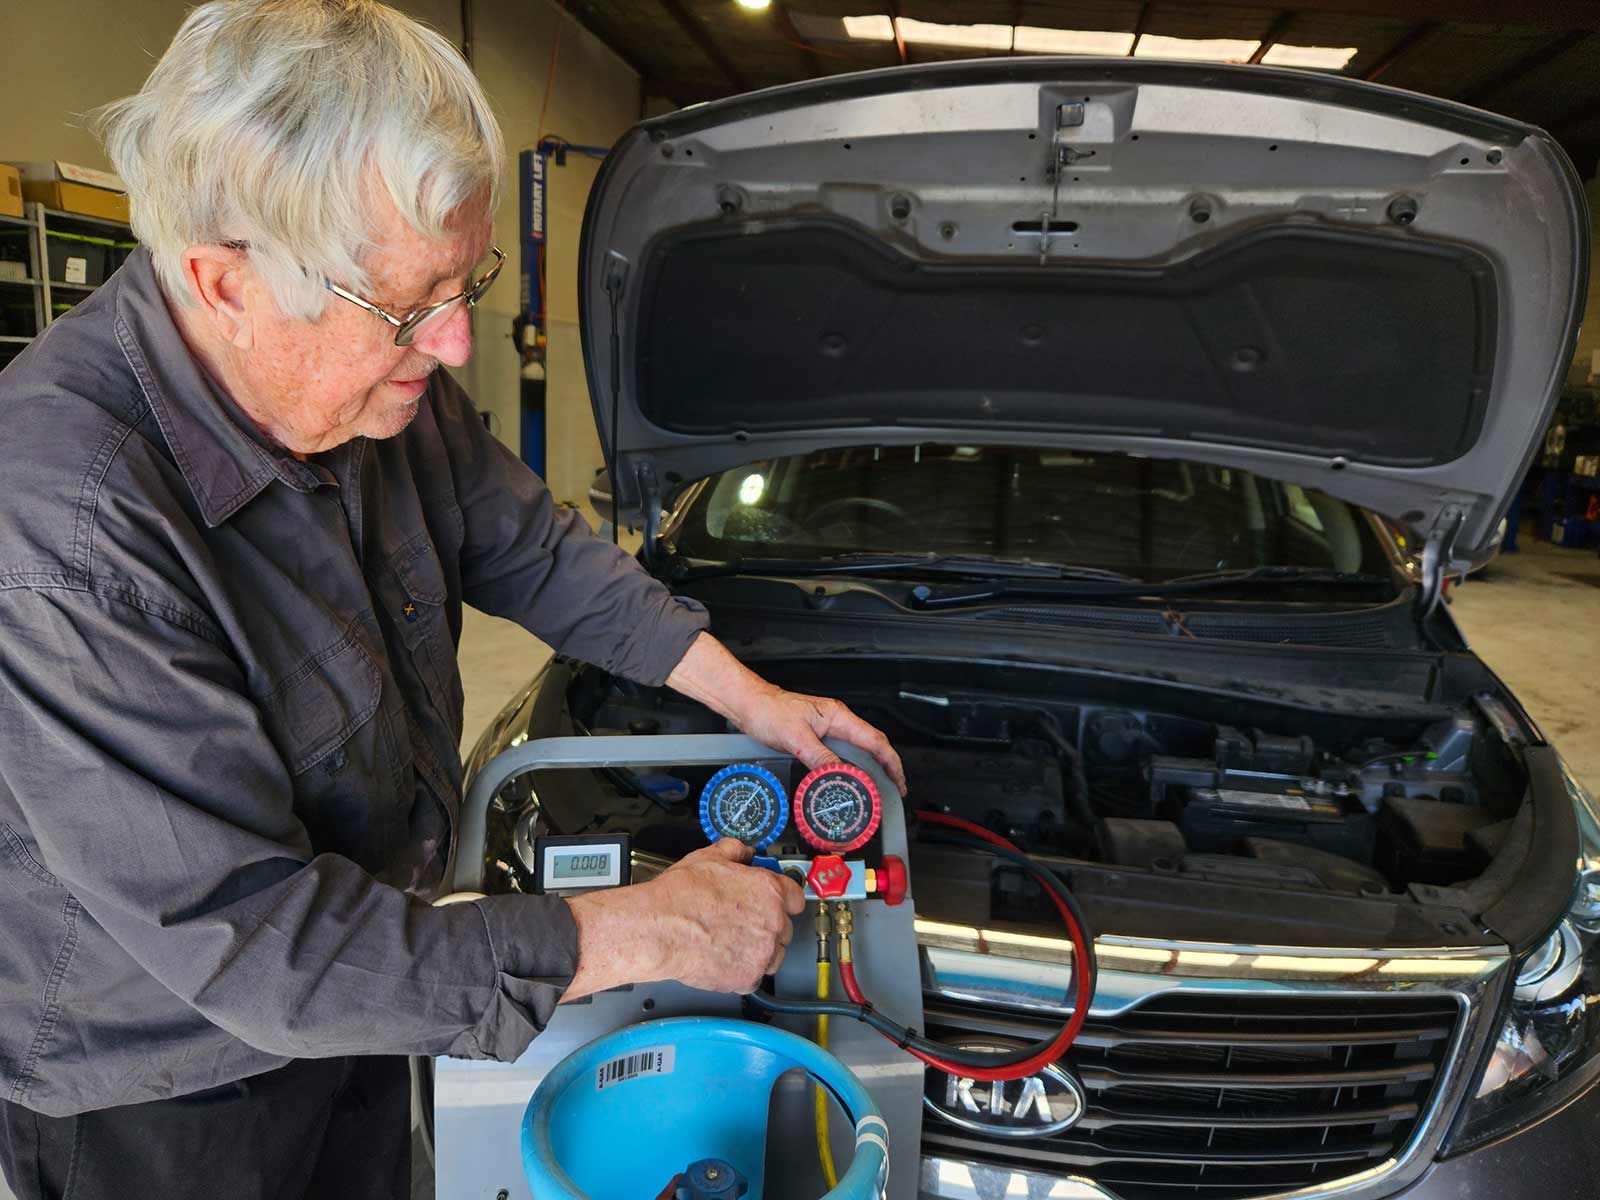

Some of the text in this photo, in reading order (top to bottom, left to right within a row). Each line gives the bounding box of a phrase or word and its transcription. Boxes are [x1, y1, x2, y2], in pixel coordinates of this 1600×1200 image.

[533, 152, 543, 231] ROTARY LIFT
[946, 1074, 1053, 1122] KIA
